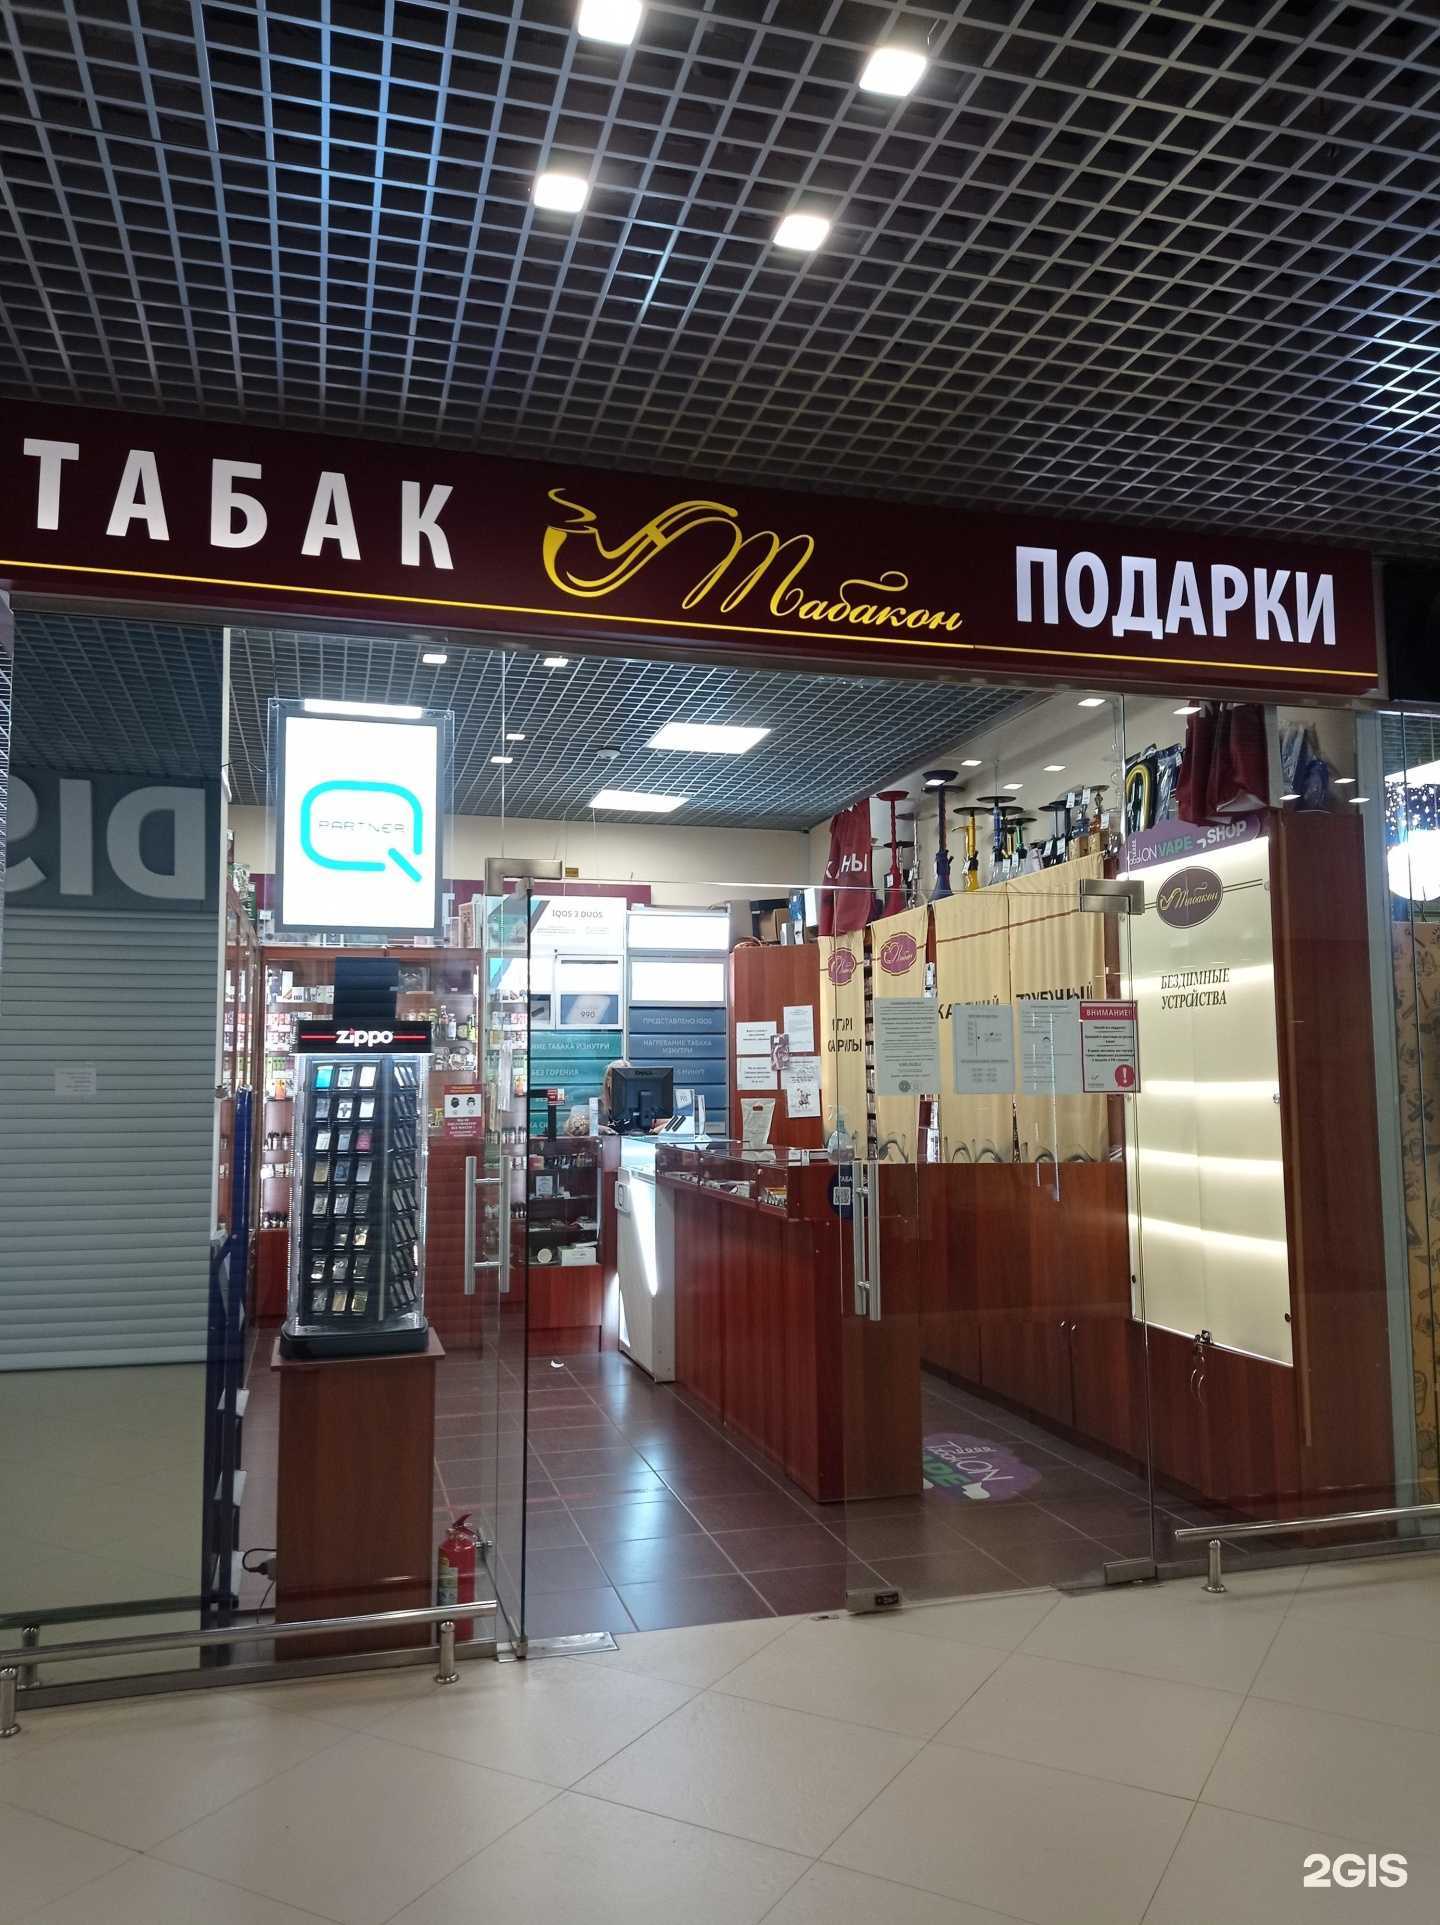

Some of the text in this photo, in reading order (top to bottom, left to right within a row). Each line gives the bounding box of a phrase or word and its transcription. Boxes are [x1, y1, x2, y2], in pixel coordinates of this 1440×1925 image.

[23, 438, 454, 570] ТАБАК
[678, 502, 964, 632] Табакон
[1016, 545, 1336, 646] ПОДАРКИ
[318, 819, 406, 835] PARTNER
[1206, 818, 1248, 845] SHOP
[552, 909, 573, 919] IQOS
